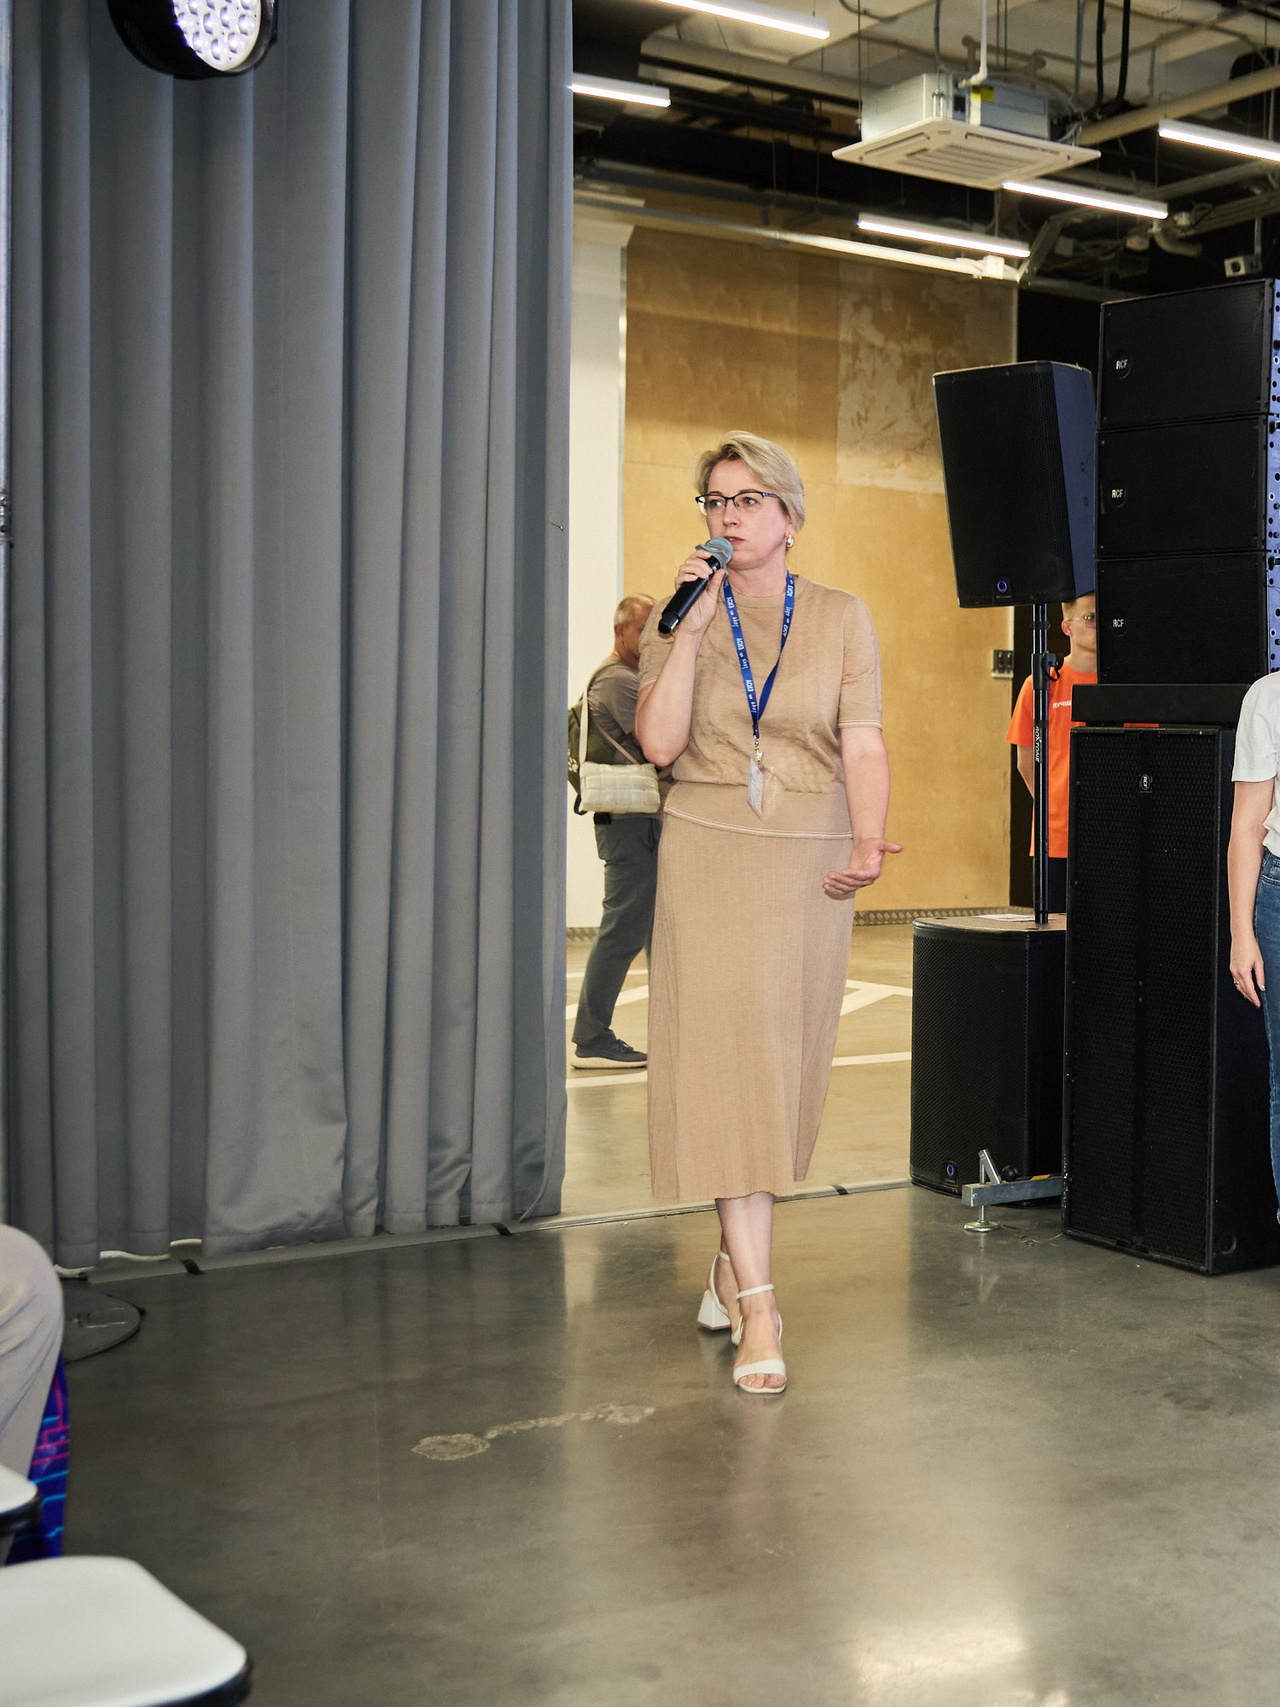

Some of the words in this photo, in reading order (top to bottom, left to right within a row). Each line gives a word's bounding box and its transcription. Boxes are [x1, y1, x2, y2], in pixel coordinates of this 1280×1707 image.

[1115, 359, 1128, 370] RCF
[1111, 489, 1124, 499] RCF
[1112, 618, 1124, 628] RCF
